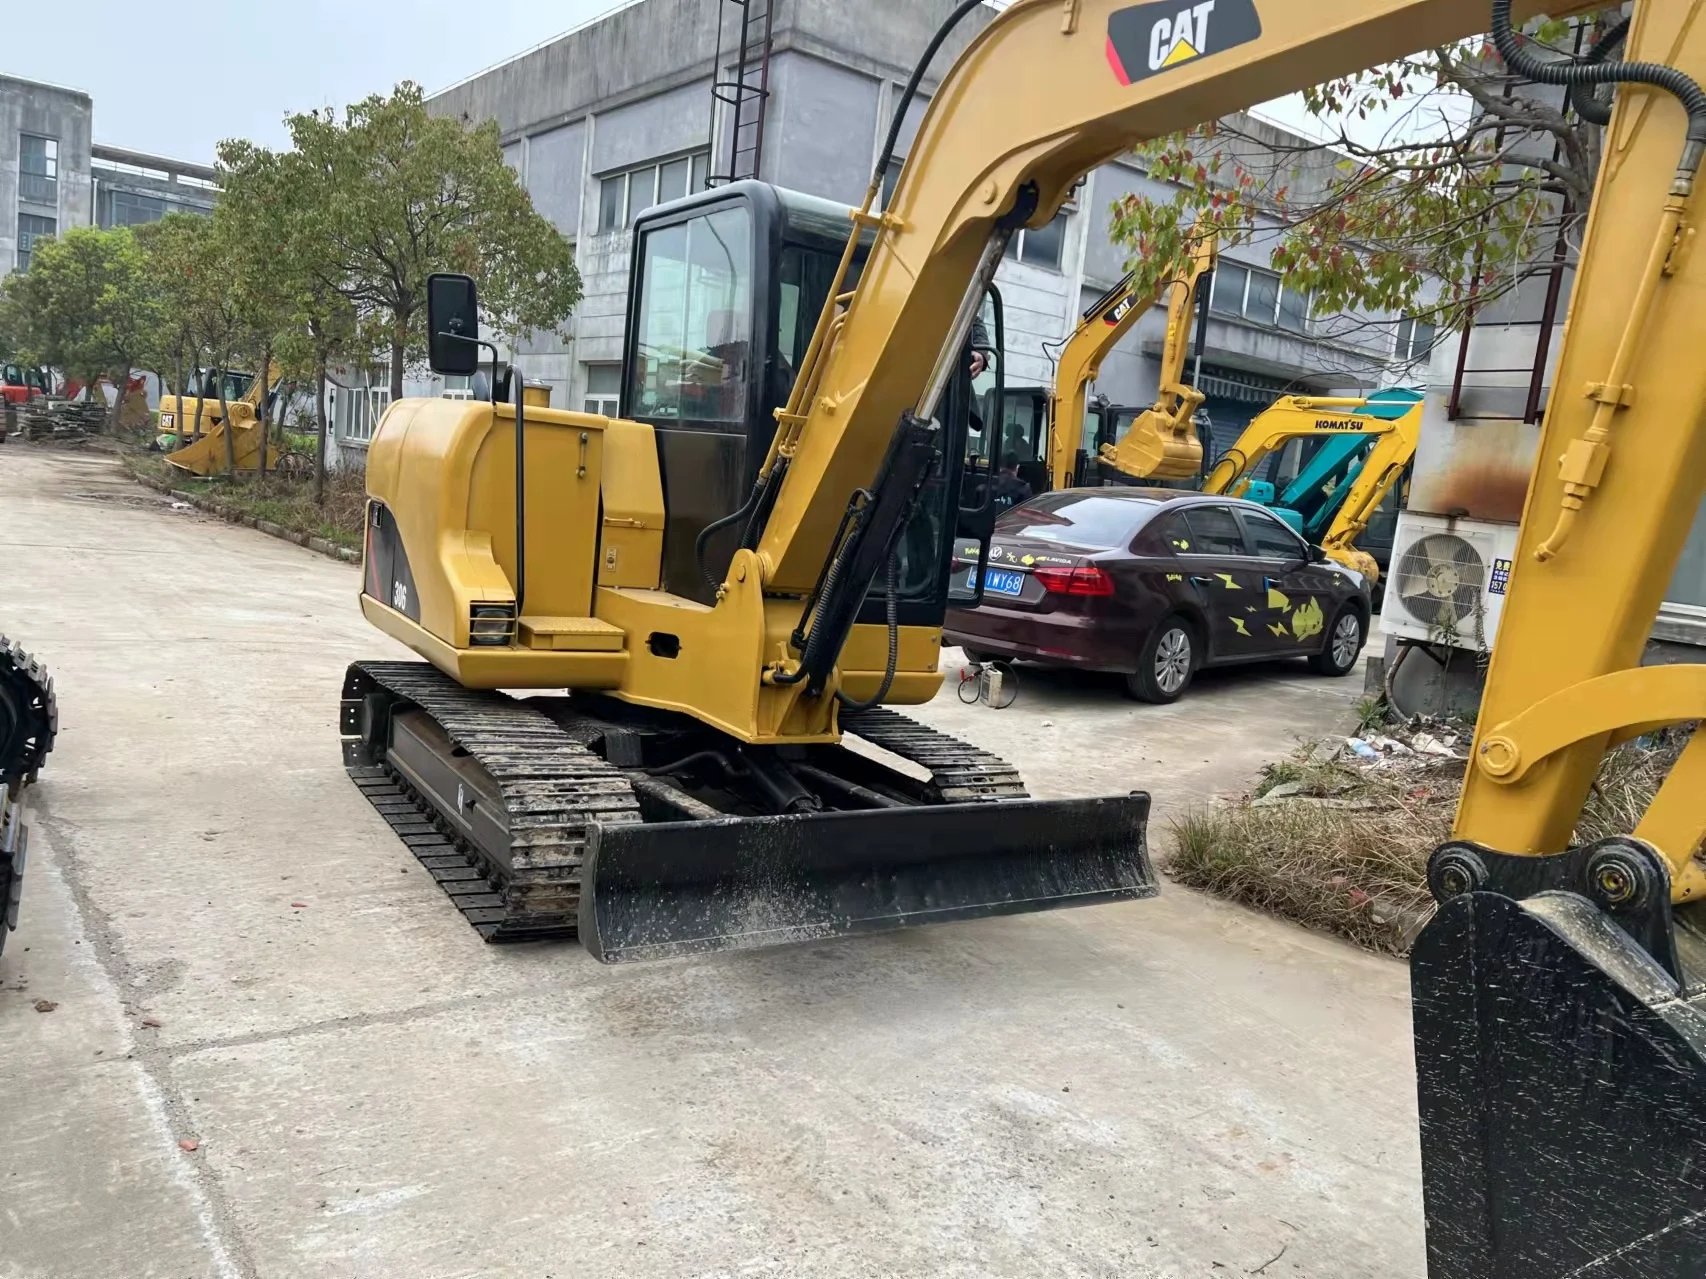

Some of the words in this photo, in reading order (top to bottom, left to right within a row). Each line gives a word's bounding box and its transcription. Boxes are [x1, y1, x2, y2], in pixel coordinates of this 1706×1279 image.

[1148, 0, 1215, 71] CAT
[1114, 298, 1130, 320] CAT
[162, 414, 173, 428] CAT
[1315, 419, 1364, 431] KOMATSU
[1047, 556, 1072, 565] LAVIDA
[394, 581, 407, 611] 306
